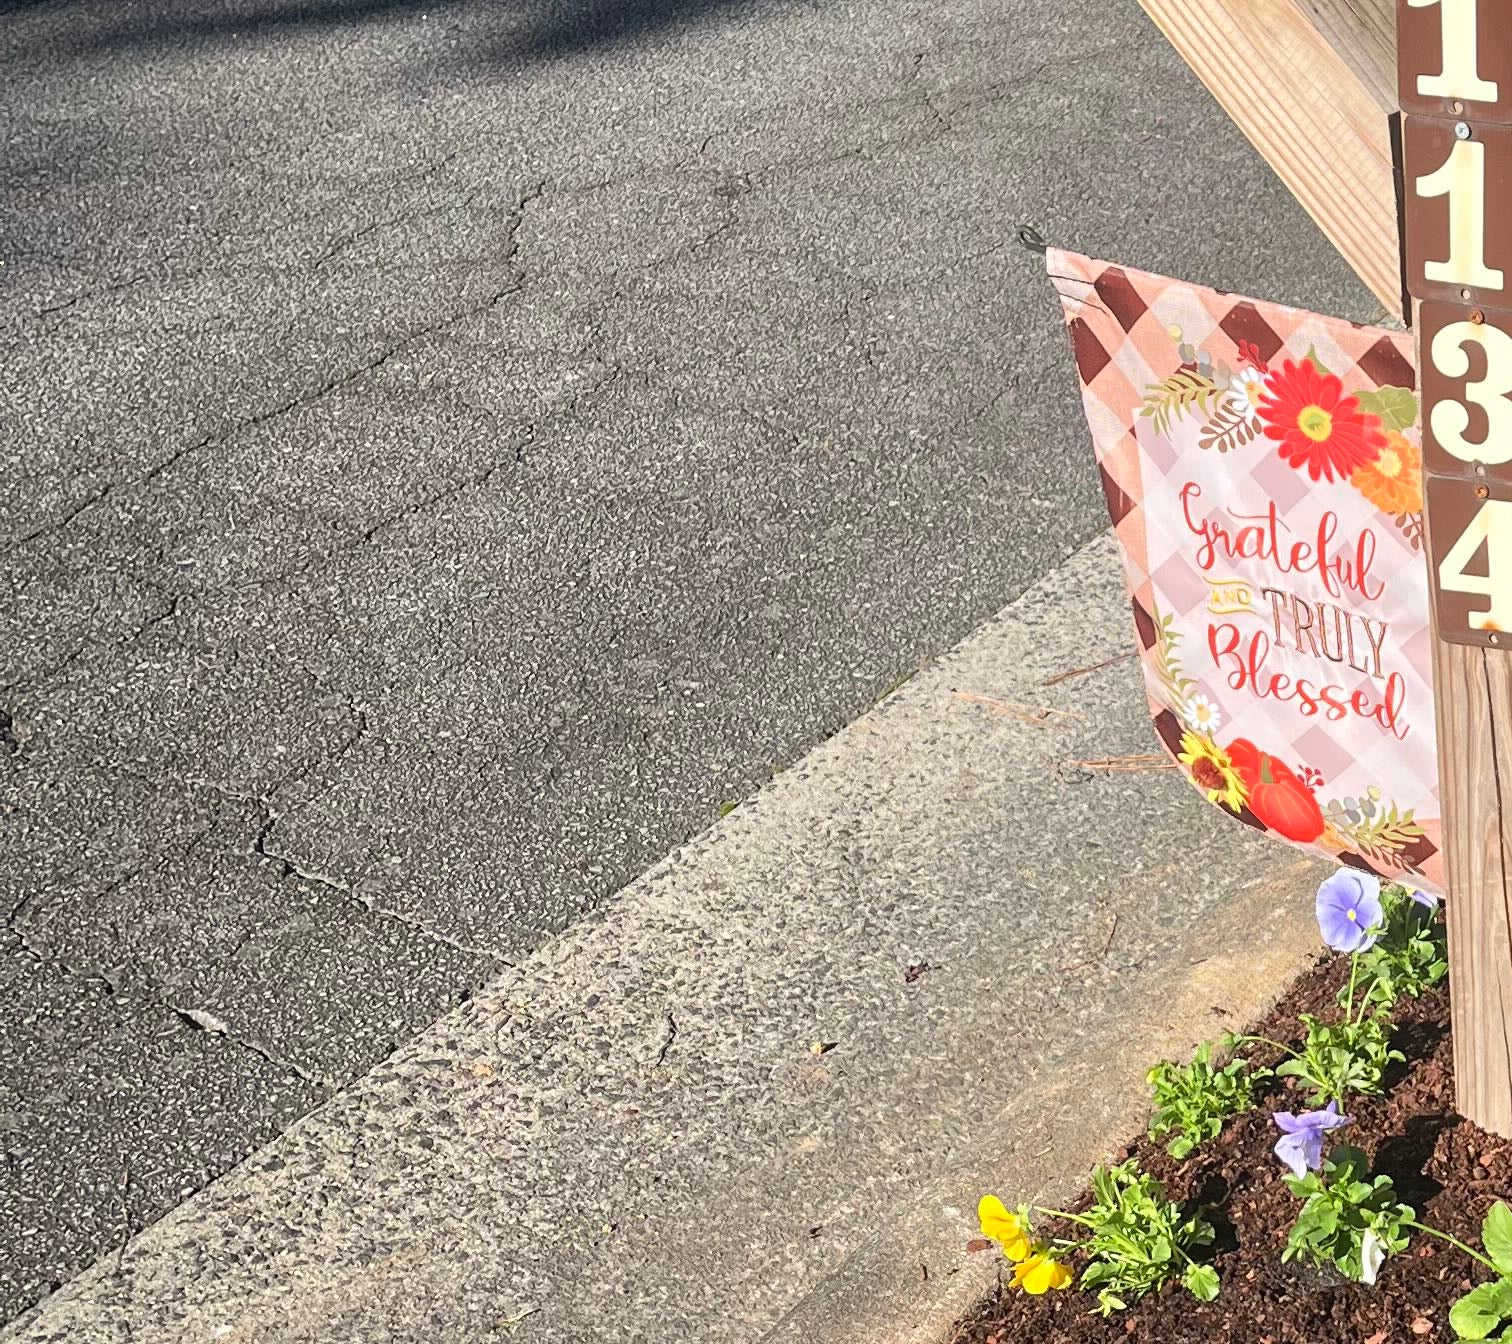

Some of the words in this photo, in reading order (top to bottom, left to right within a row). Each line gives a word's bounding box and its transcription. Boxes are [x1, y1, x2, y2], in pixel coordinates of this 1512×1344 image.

[1179, 481, 1386, 601] Grateful
[1207, 623, 1411, 741] Blessed
[1209, 587, 1252, 606] AND
[1261, 586, 1390, 680] TRULY
